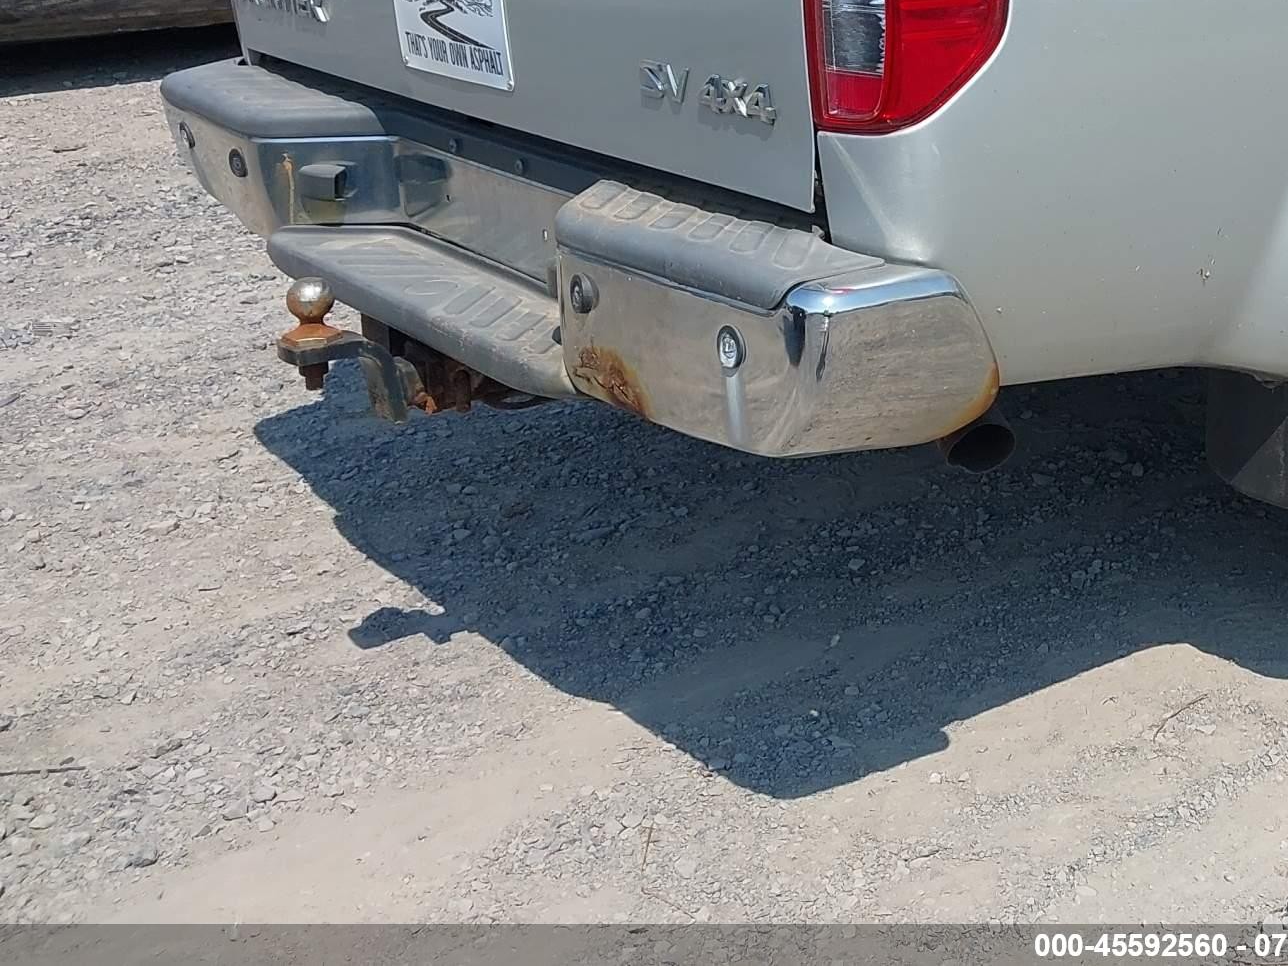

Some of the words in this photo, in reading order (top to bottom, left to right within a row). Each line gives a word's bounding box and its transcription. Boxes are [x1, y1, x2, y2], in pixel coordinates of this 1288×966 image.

[405, 31, 428, 59] THAT'S
[428, 37, 449, 64] YOUR
[449, 42, 469, 69] OWN
[469, 46, 504, 76] ASPHALT
